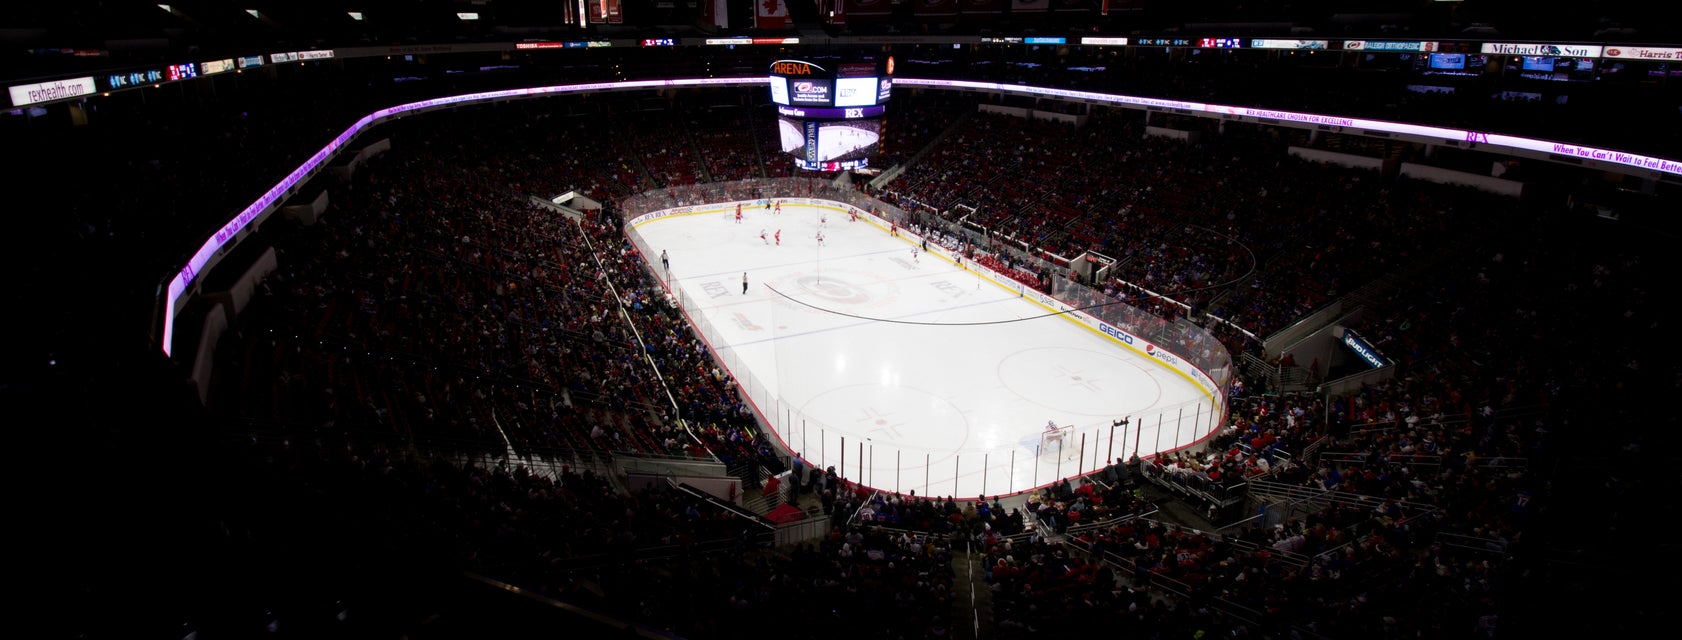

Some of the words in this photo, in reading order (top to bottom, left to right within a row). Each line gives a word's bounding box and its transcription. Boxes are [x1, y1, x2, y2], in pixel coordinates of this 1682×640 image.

[1364, 41, 1384, 50] RALEIGH
[1492, 44, 1538, 55] Michael
[1563, 46, 1588, 57] Son
[1639, 50, 1672, 58] Harris
[773, 61, 811, 75] ARENA
[28, 82, 84, 103] rexhealth.com
[845, 108, 864, 118] REX
[1287, 112, 1308, 122] CHOSEN
[1321, 115, 1353, 126] EXCELLENCE
[1465, 132, 1488, 144] REX
[1553, 144, 1574, 155] When
[1576, 147, 1590, 158] You
[1592, 149, 1613, 160] Can't
[1615, 152, 1633, 163] Wait
[1634, 156, 1642, 166] to
[1643, 157, 1660, 168] Feel
[1661, 161, 1682, 173] Bette
[1099, 323, 1134, 345] GEICO
[1156, 350, 1178, 366] pepsi
[1348, 337, 1363, 353] BUD
[1362, 349, 1384, 369] LIGHT
